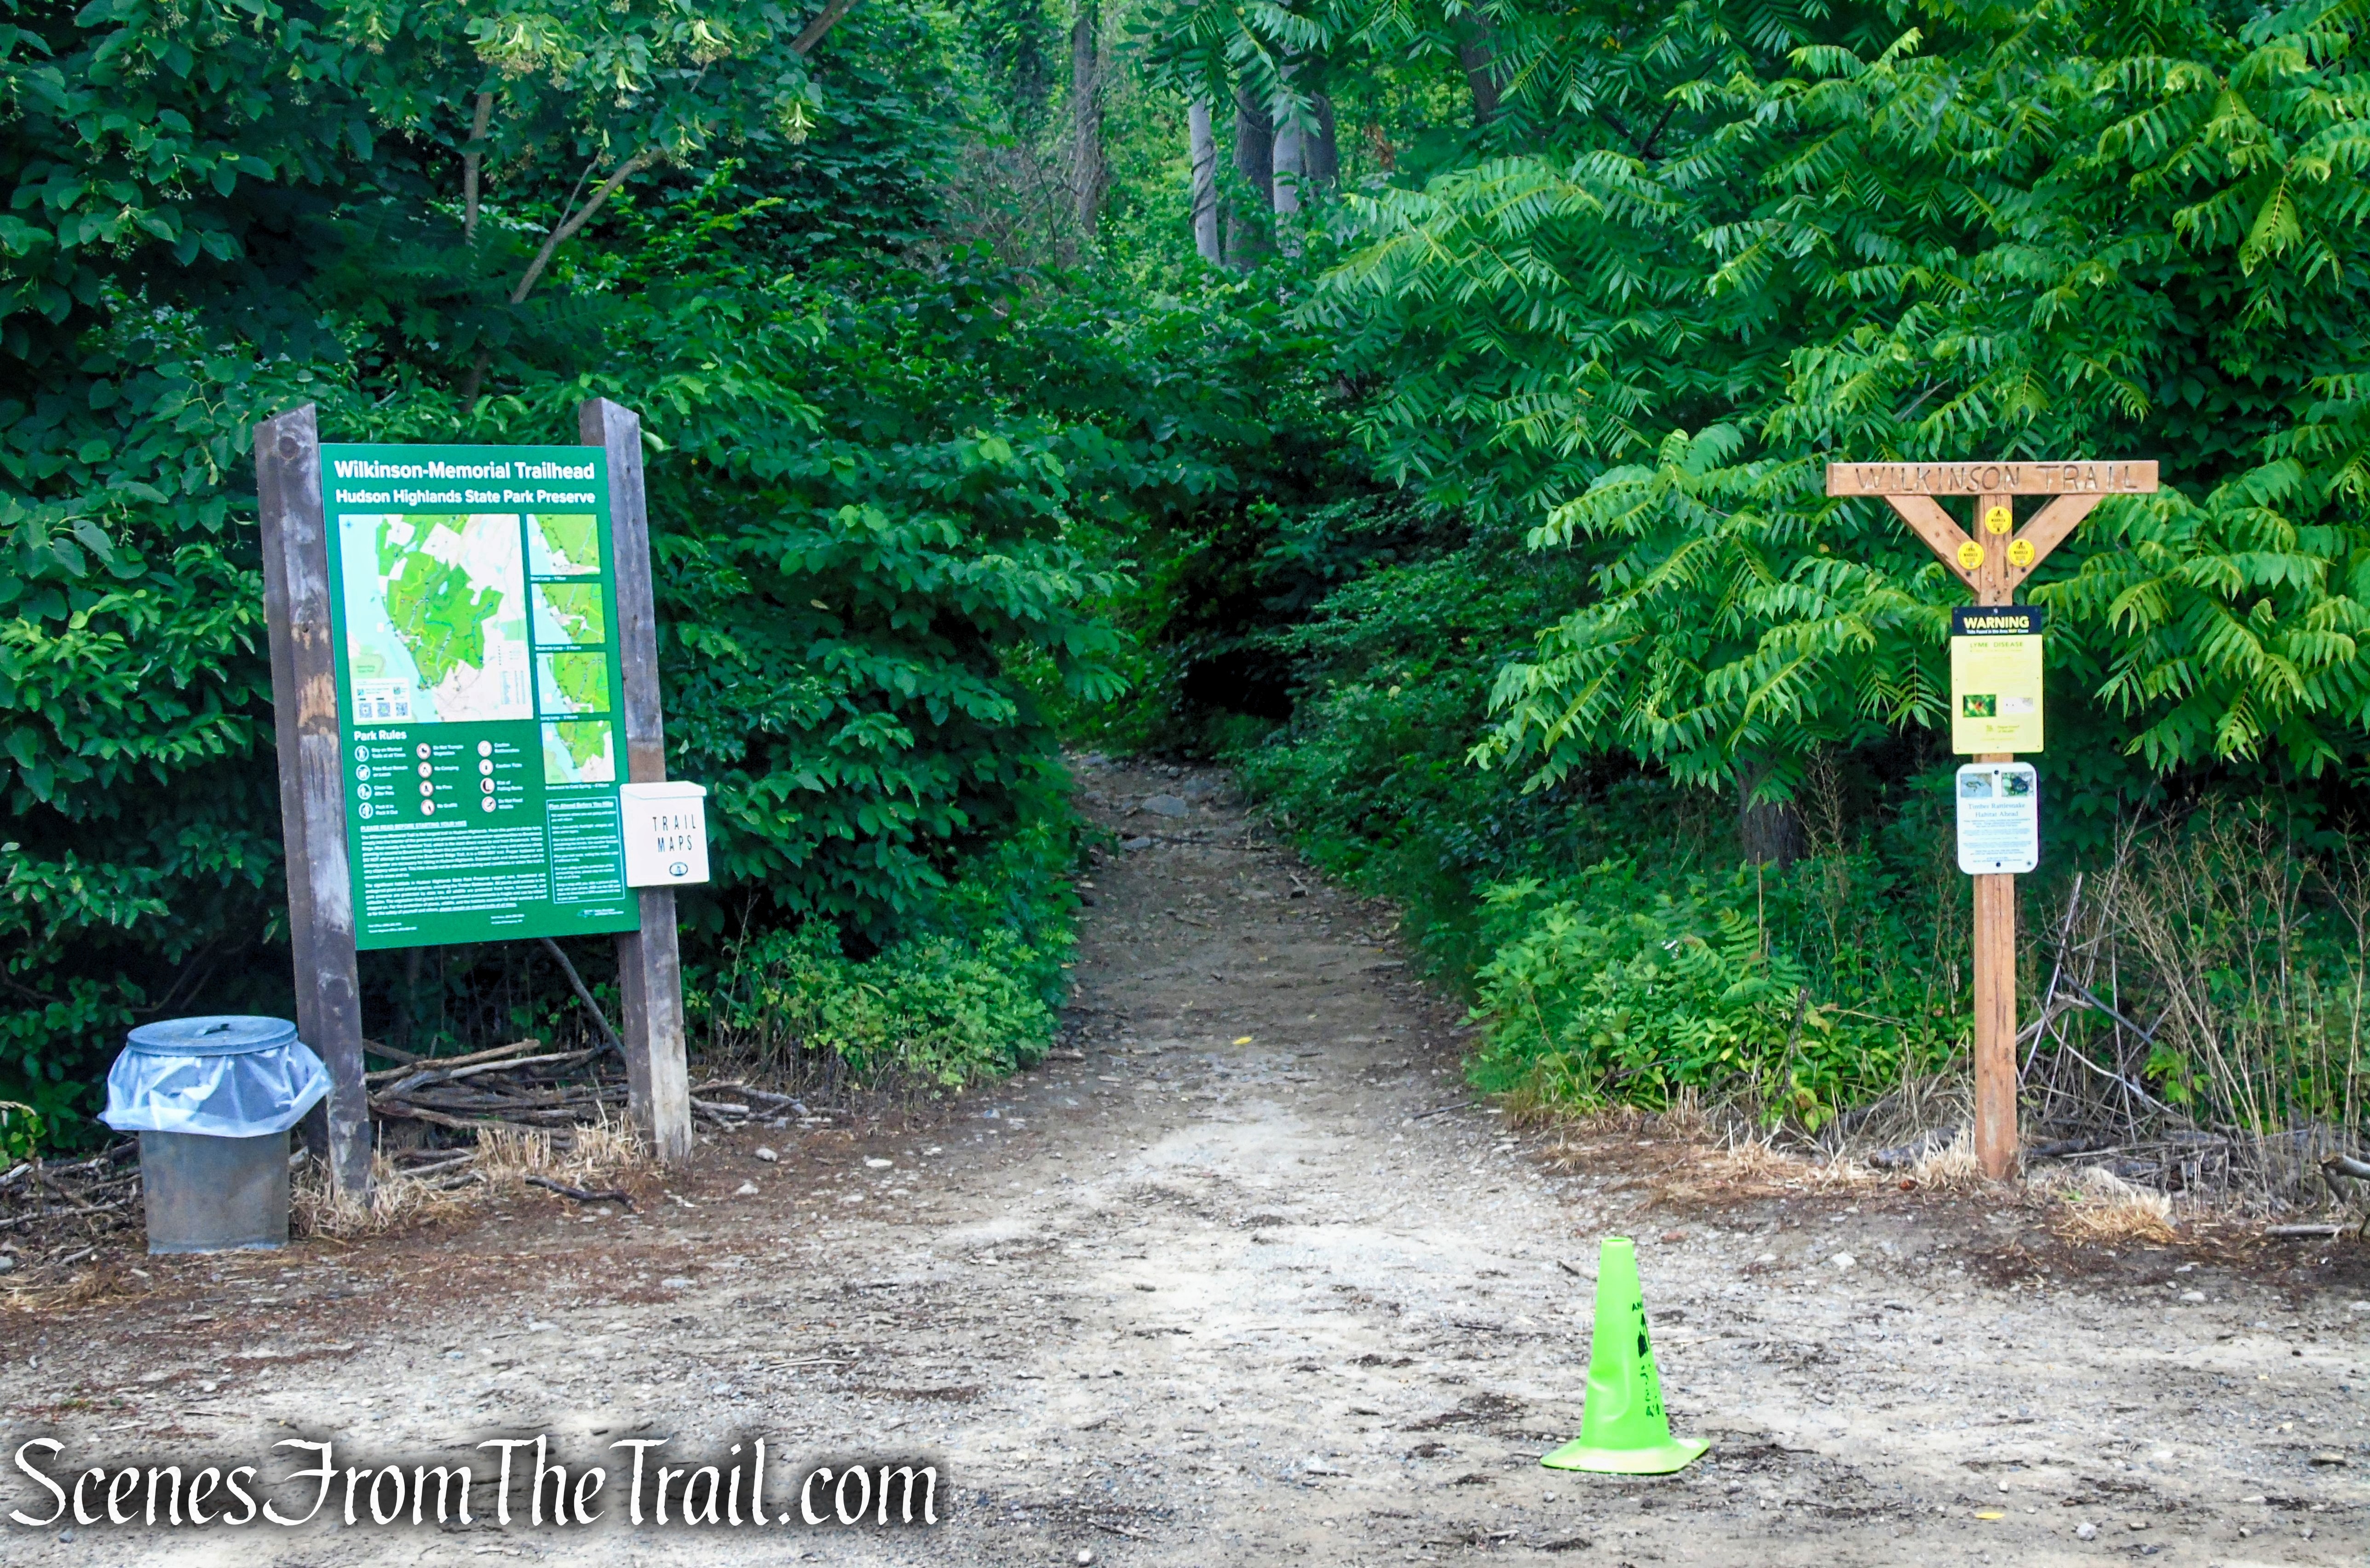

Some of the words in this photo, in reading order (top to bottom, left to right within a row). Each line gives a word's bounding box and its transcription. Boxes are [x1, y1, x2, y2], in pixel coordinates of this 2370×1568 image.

[334, 460, 511, 479] Wilkinson-Memorial
[514, 461, 595, 479] Trailhead
[1855, 465, 2021, 492] WILKINSON
[2036, 465, 2138, 489] TRAIL
[335, 489, 391, 503] Hudson
[393, 489, 461, 506] Highlands
[465, 489, 500, 503] State
[503, 490, 535, 503] Park
[536, 490, 596, 503] Preserve
[1964, 616, 2029, 629] WARNING
[354, 730, 377, 741] Park
[378, 729, 407, 740] Rules
[652, 814, 696, 832] TRAIL
[658, 835, 692, 853] MAPS
